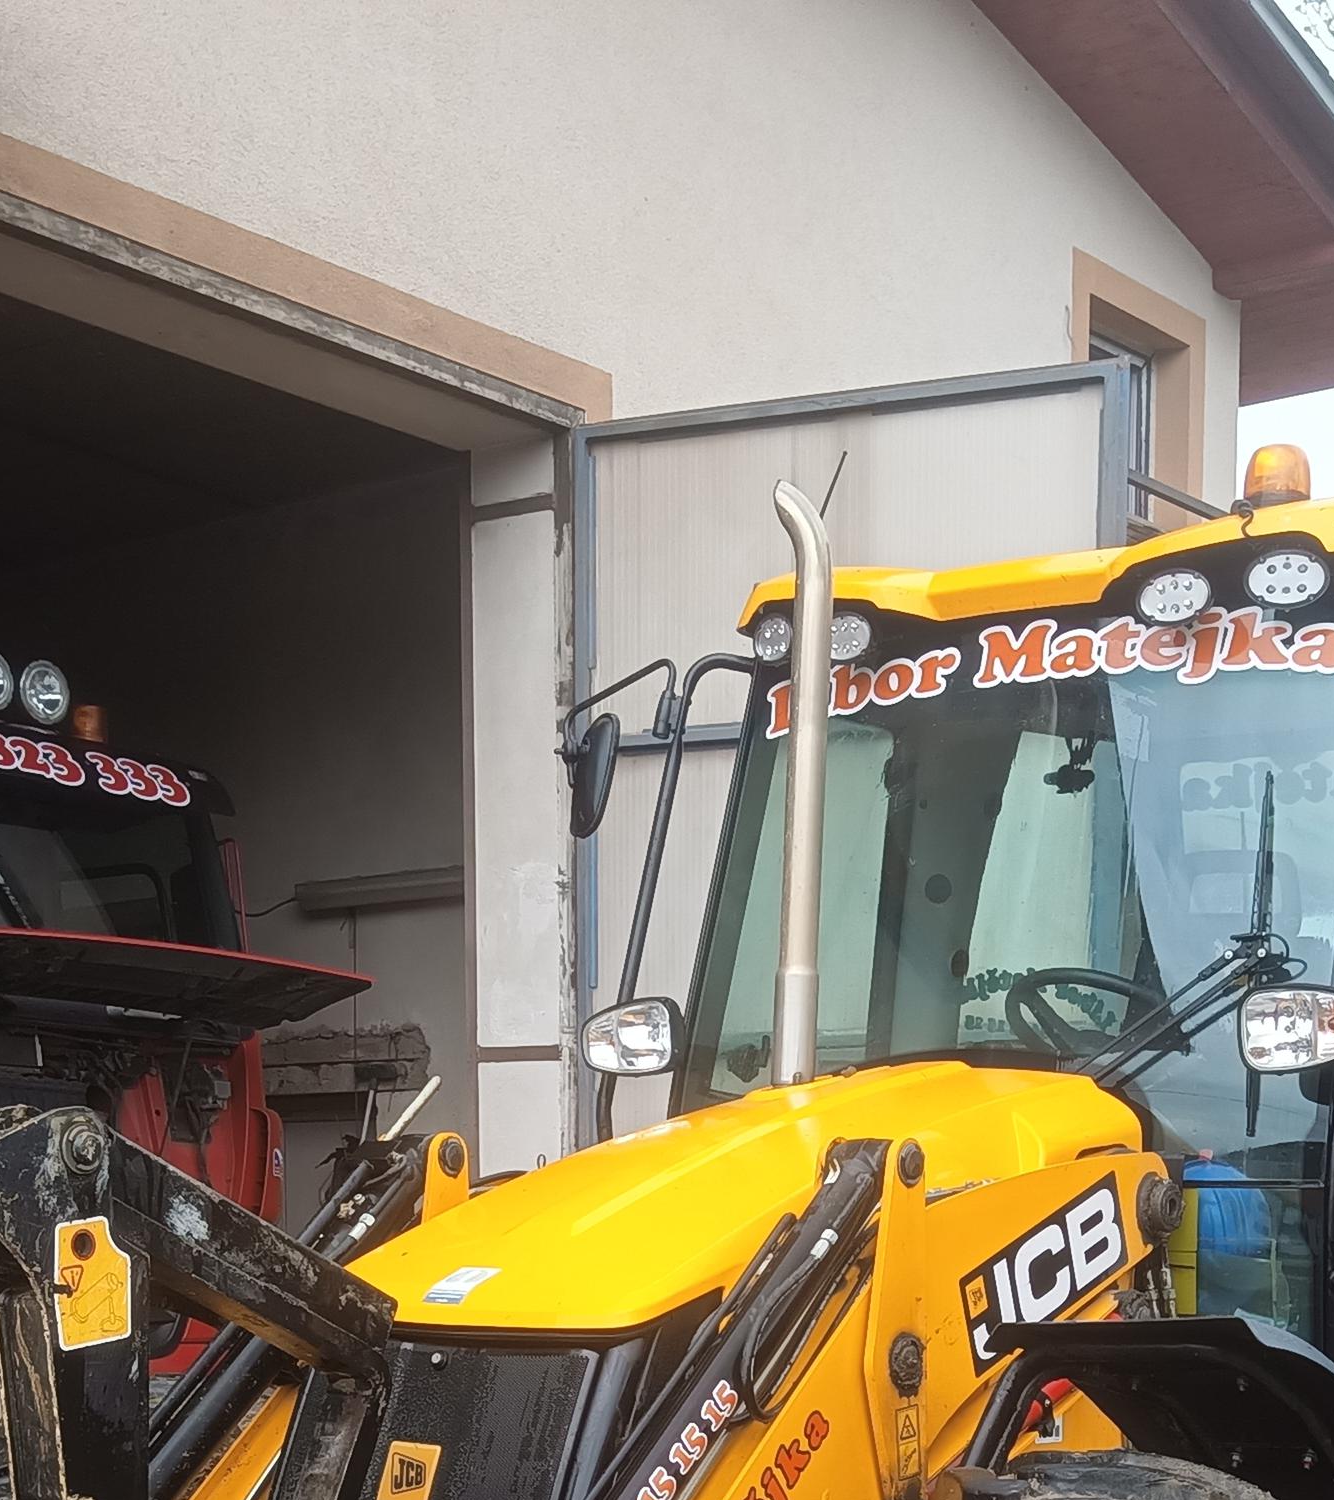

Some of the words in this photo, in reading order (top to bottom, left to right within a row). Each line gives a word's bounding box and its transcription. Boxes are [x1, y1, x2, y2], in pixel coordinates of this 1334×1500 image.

[85, 751, 191, 807] 333
[973, 1188, 1122, 1361] JCB
[669, 1422, 709, 1476] 15
[701, 1379, 739, 1432] 15
[393, 1457, 424, 1490] JCB
